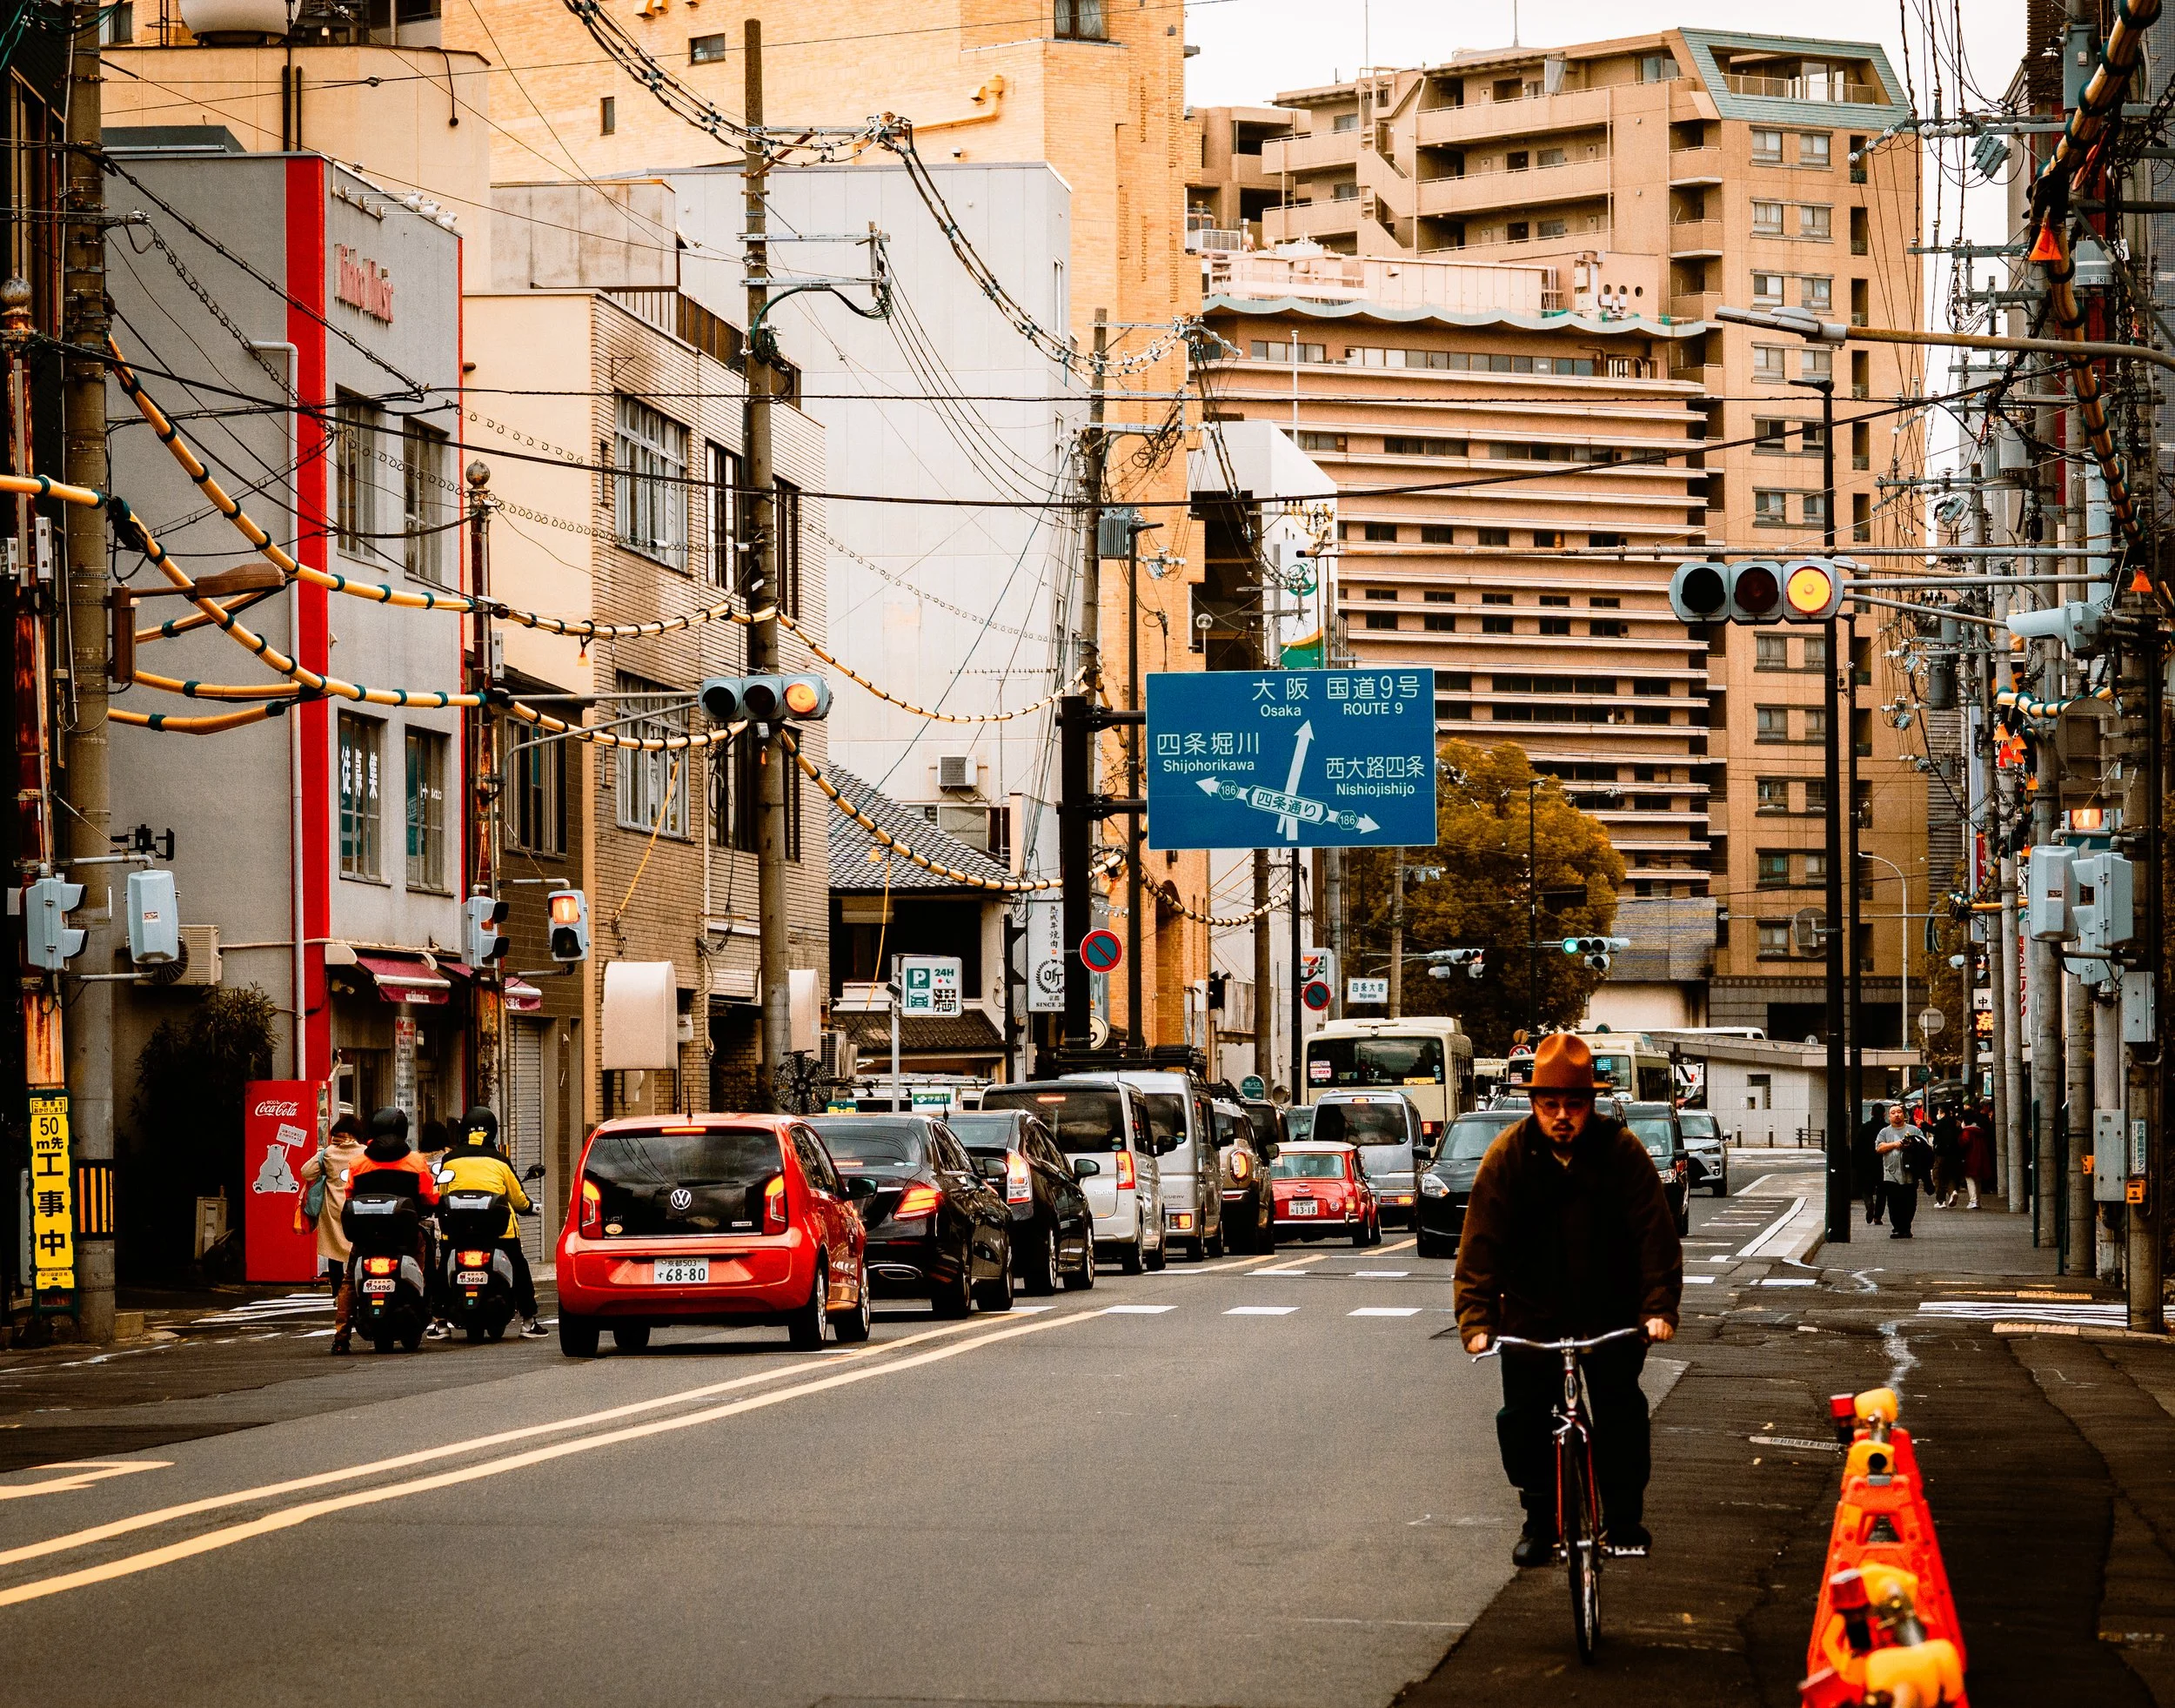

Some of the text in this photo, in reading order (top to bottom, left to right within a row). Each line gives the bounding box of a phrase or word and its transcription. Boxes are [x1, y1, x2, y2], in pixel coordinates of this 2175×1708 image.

[1252, 675, 1420, 701] 大阪 国道9号
[1260, 704, 1302, 717] Osaka
[1343, 702, 1403, 716] ROUTE 9
[1157, 732, 1260, 756] 四条堀川
[1162, 759, 1255, 774] Shijohorikawa
[1326, 755, 1425, 780] 西大路四条
[1221, 785, 1236, 795] 186
[1335, 783, 1415, 798] Nishiojishijo
[1256, 791, 1317, 818] 四条通り
[1340, 814, 1355, 826] 186
[934, 968, 954, 977] 24H
[40, 1116, 59, 1136] 50
[36, 1136, 64, 1150] m先
[37, 1152, 66, 1256] 工事中
[1295, 1206, 1316, 1215] 13-18
[666, 1268, 706, 1282] 68-80
